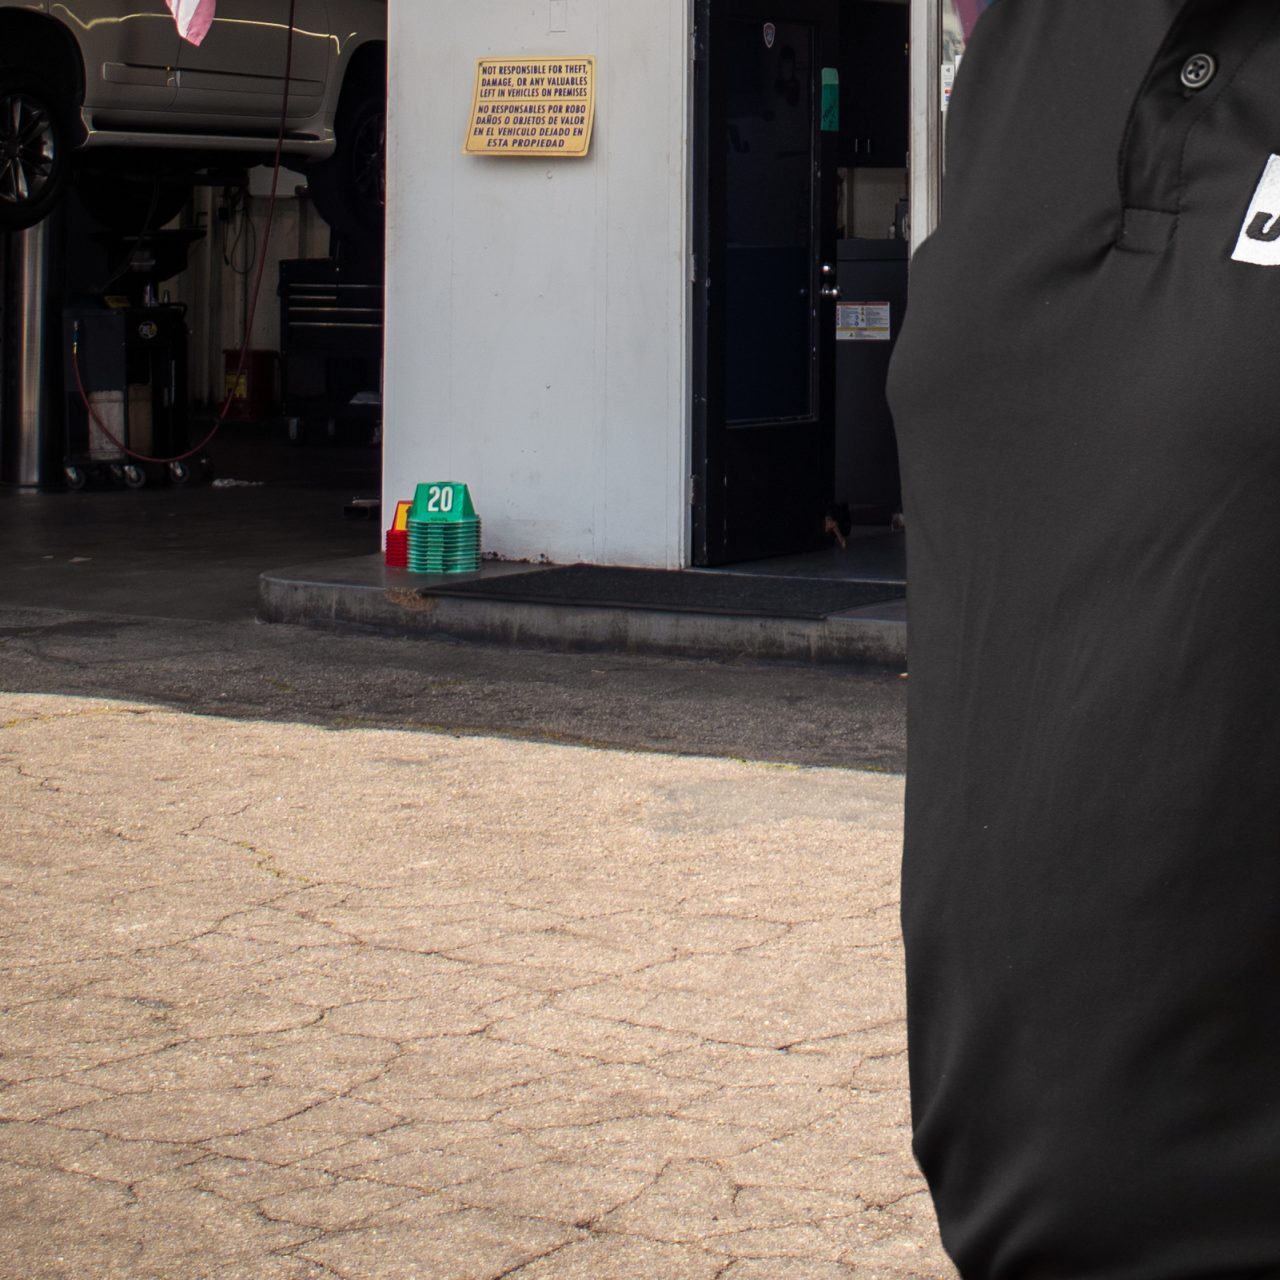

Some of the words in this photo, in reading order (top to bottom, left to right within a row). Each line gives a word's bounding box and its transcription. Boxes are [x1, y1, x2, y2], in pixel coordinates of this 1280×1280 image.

[482, 66, 496, 75] NOT
[499, 65, 545, 75] RESPONSIBLE
[548, 65, 562, 73] FOR
[517, 78, 527, 86] OR
[530, 78, 544, 86] ANY
[548, 76, 587, 86] VALUABLES
[480, 89, 495, 98] LEFT
[498, 89, 505, 97] IN
[508, 88, 539, 97] VEHICLES
[542, 88, 551, 96] ON
[554, 88, 587, 96] PREMISES
[478, 105, 489, 113] NO
[491, 105, 545, 113] RESPONSABLES
[548, 105, 562, 113] POR
[566, 105, 586, 113] ROBO
[476, 115, 501, 125] DAÑOS
[505, 116, 510, 124] O
[513, 116, 545, 125] OBJETOS
[548, 116, 557, 125] DE
[561, 116, 584, 125] VALOR
[474, 128, 483, 136] EN
[486, 128, 494, 136] EL
[498, 128, 536, 136] VEHICULO
[540, 128, 570, 136] DEJADO
[573, 128, 583, 136] EN
[487, 139, 508, 147] ESTA
[512, 139, 564, 147] PROPIEDAD
[427, 486, 454, 512] 20
